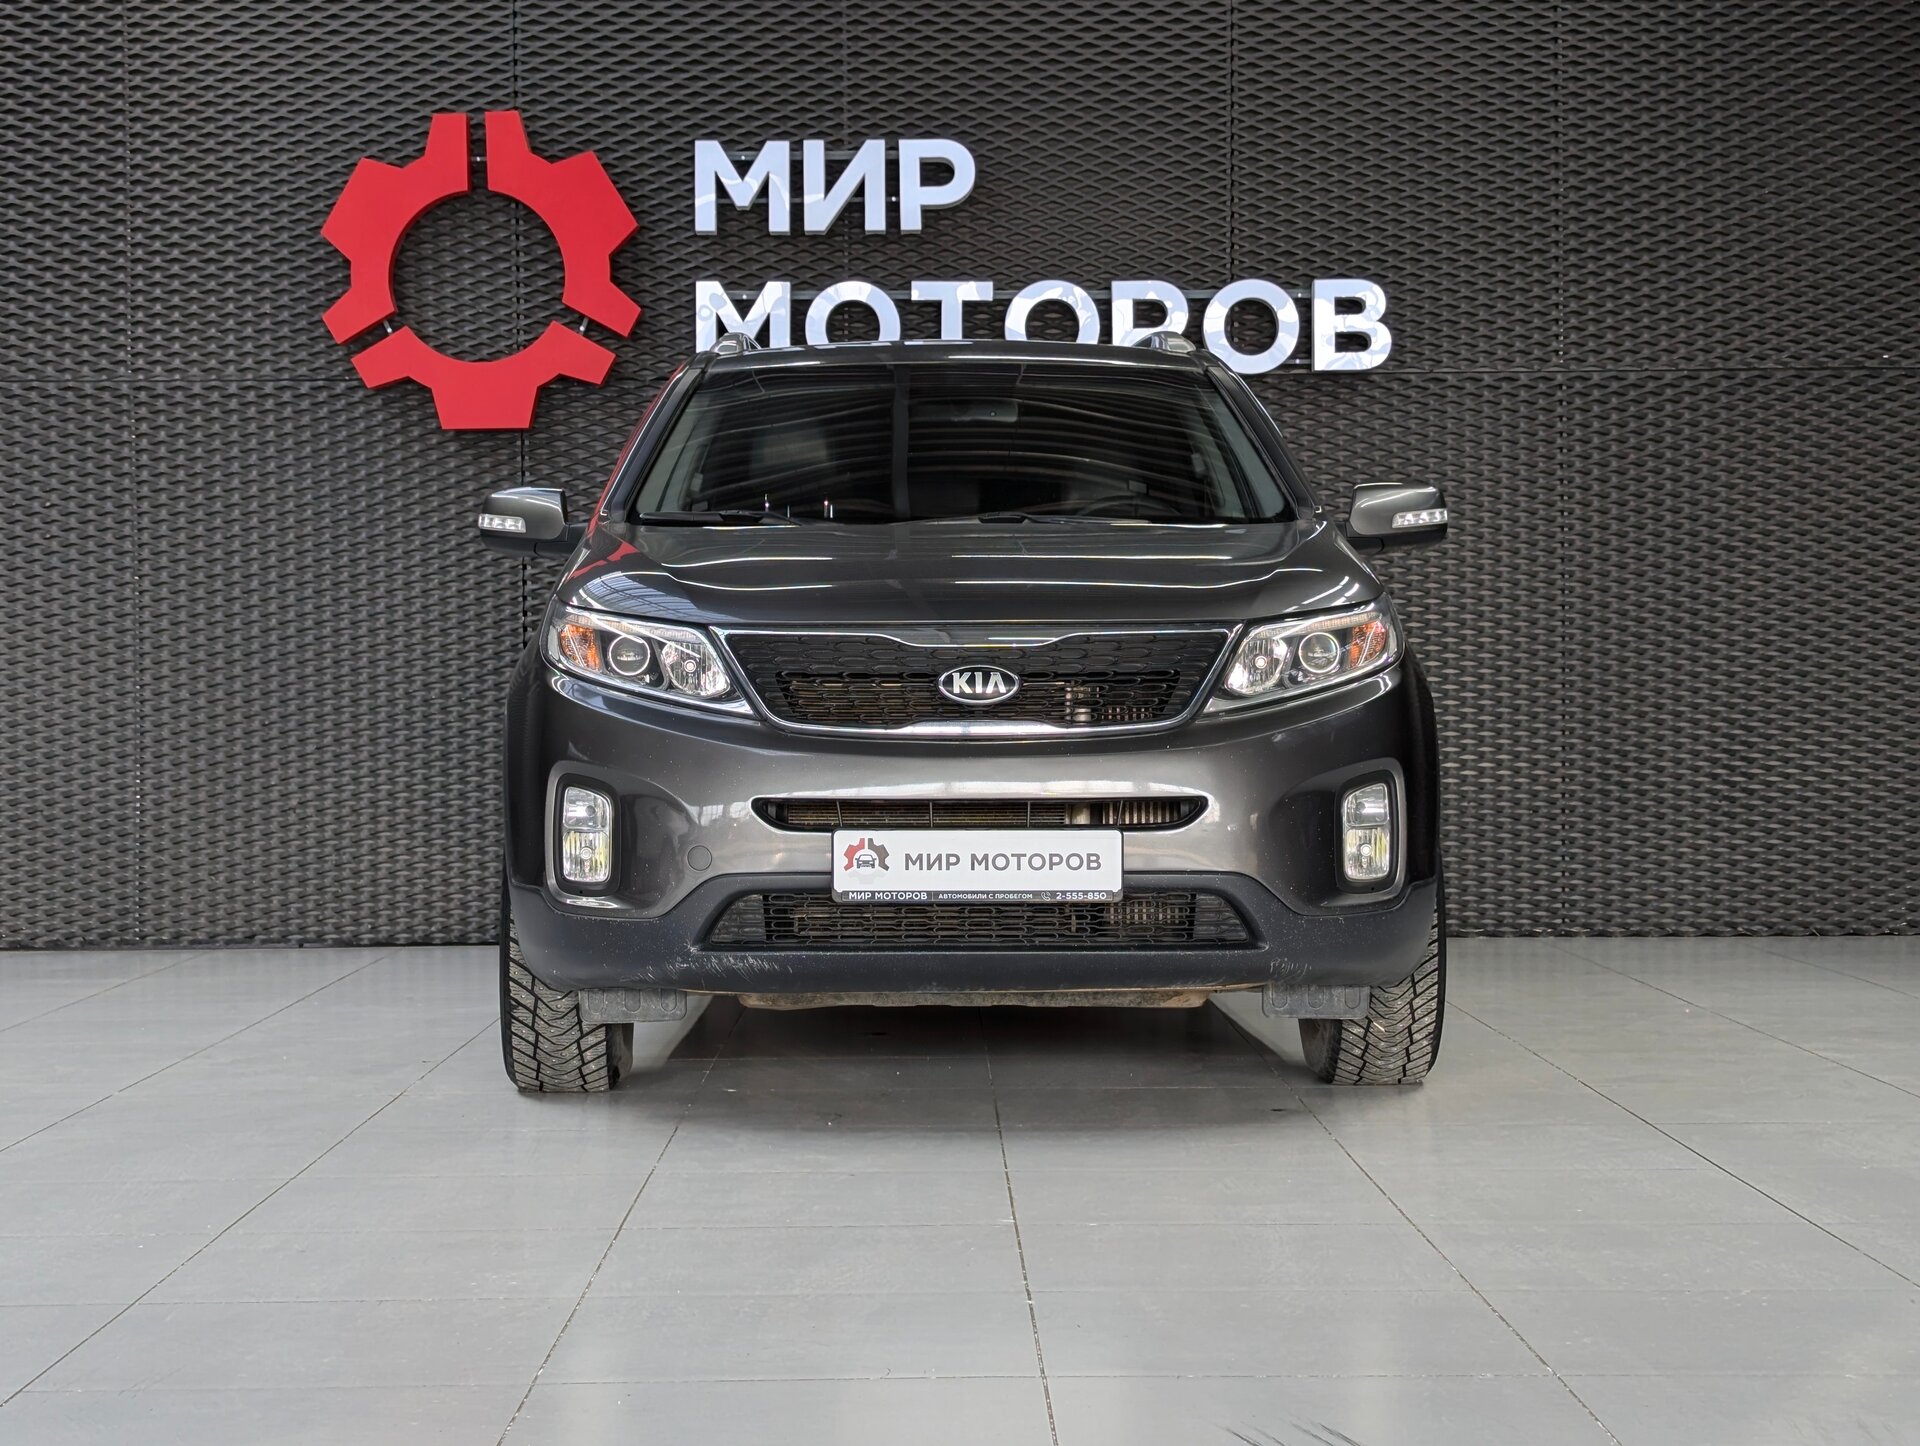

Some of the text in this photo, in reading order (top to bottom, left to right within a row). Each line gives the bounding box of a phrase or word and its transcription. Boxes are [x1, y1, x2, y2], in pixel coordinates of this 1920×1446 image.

[695, 139, 976, 235] МИР
[695, 279, 1393, 374] МОТОРОВ
[952, 672, 1006, 694] KIA
[904, 853, 1102, 871] МИР МОТОРОВ
[848, 892, 928, 900] МИР МОТОРОВ
[1055, 892, 1107, 900] 2-555-850
